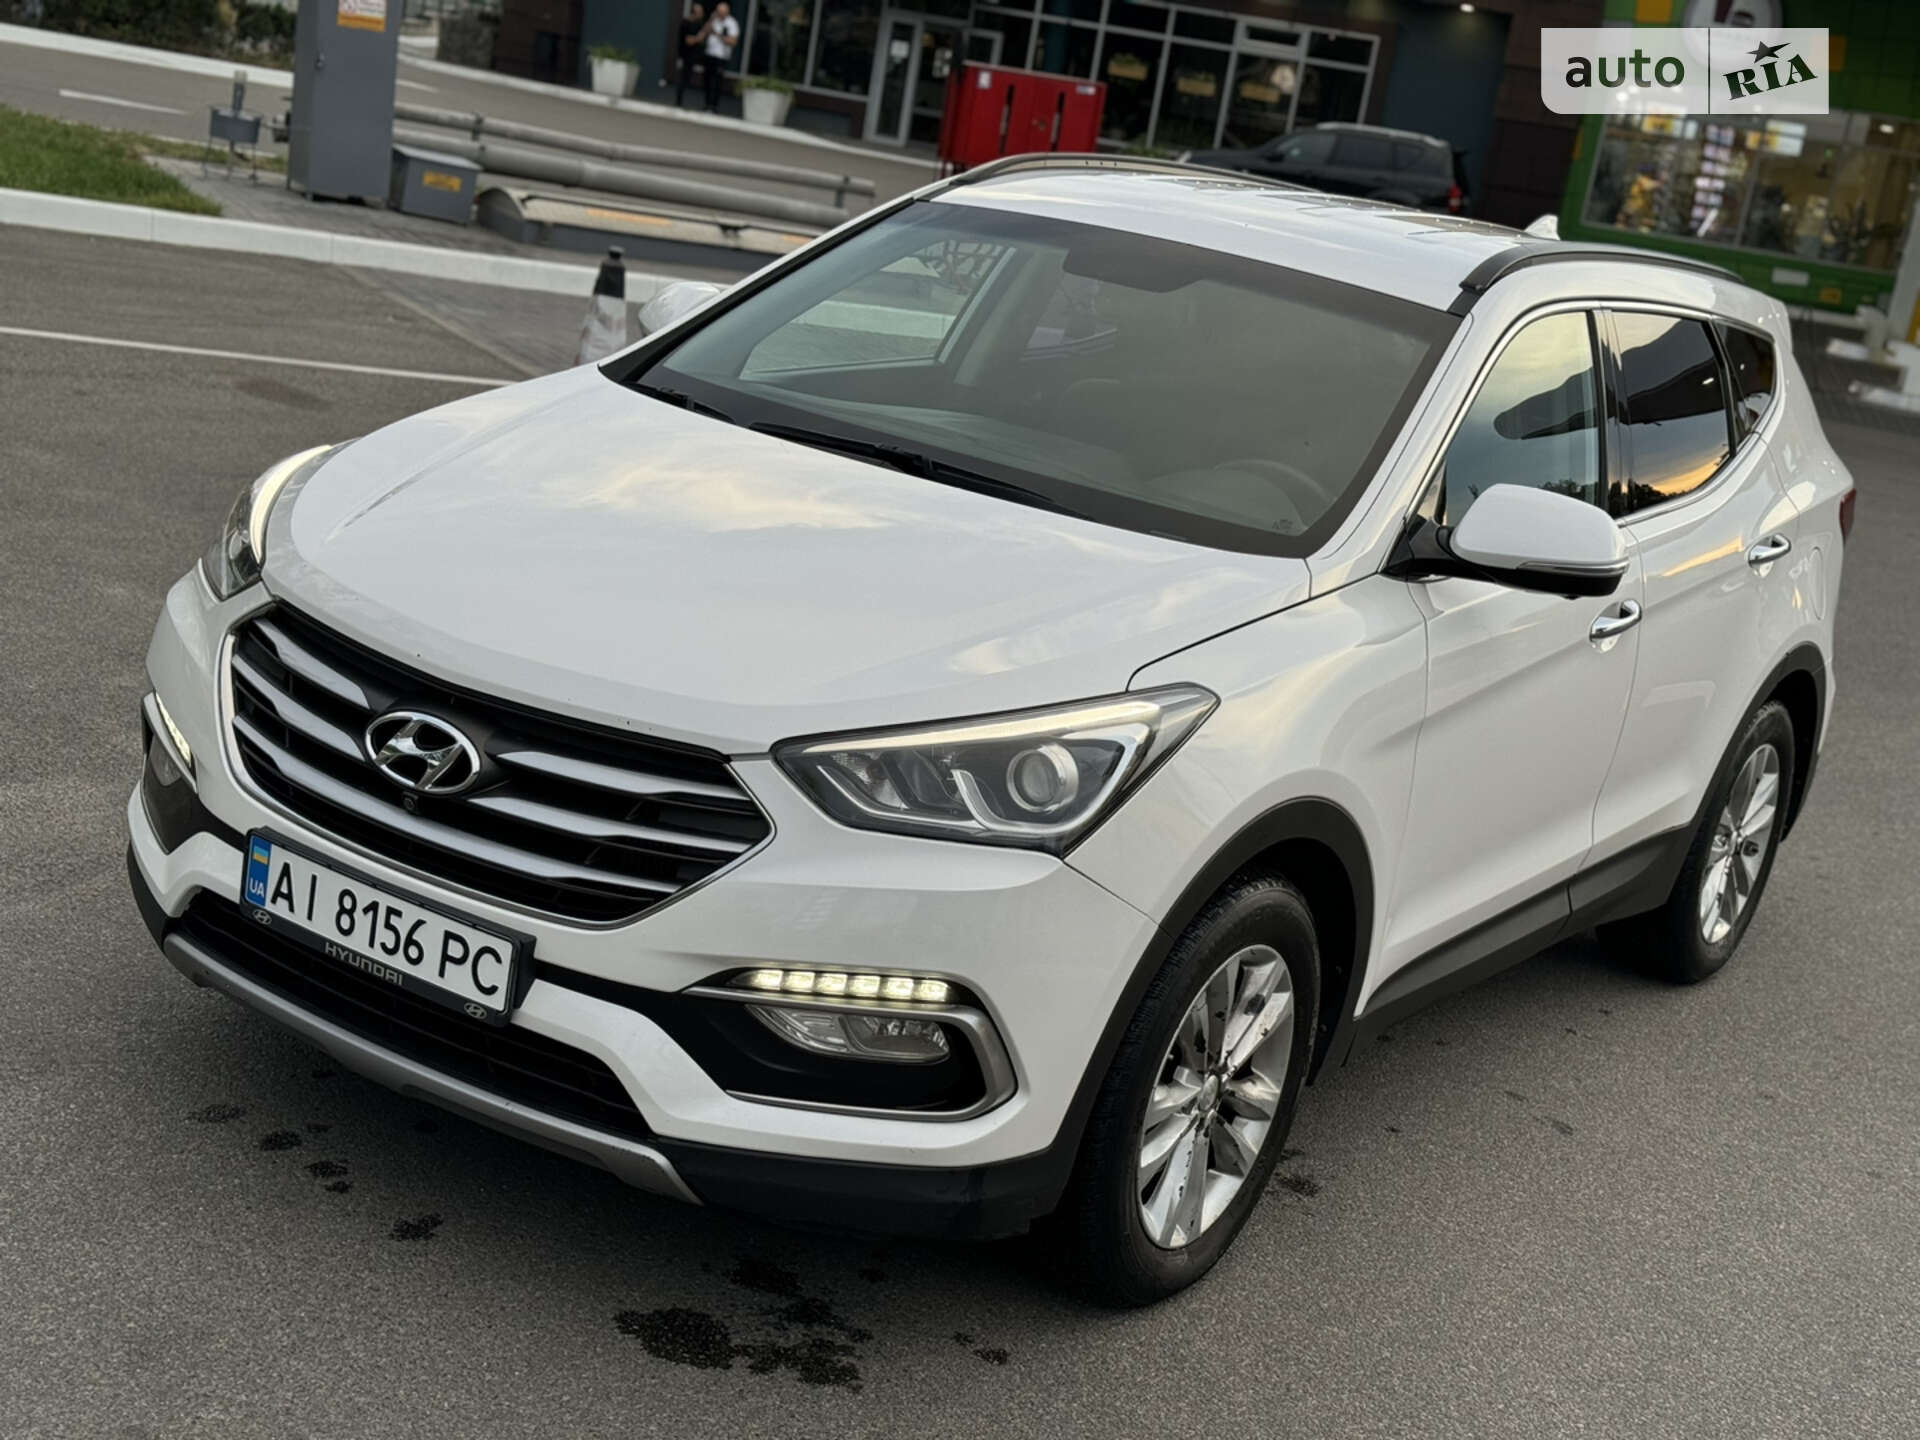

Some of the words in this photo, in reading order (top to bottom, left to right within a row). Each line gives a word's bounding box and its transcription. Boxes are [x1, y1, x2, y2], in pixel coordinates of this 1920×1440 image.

[249, 878, 265, 898] UA
[270, 861, 317, 921] AI
[335, 888, 426, 966] 8156
[438, 930, 503, 996] PC
[325, 942, 403, 986] HYUNDAI
